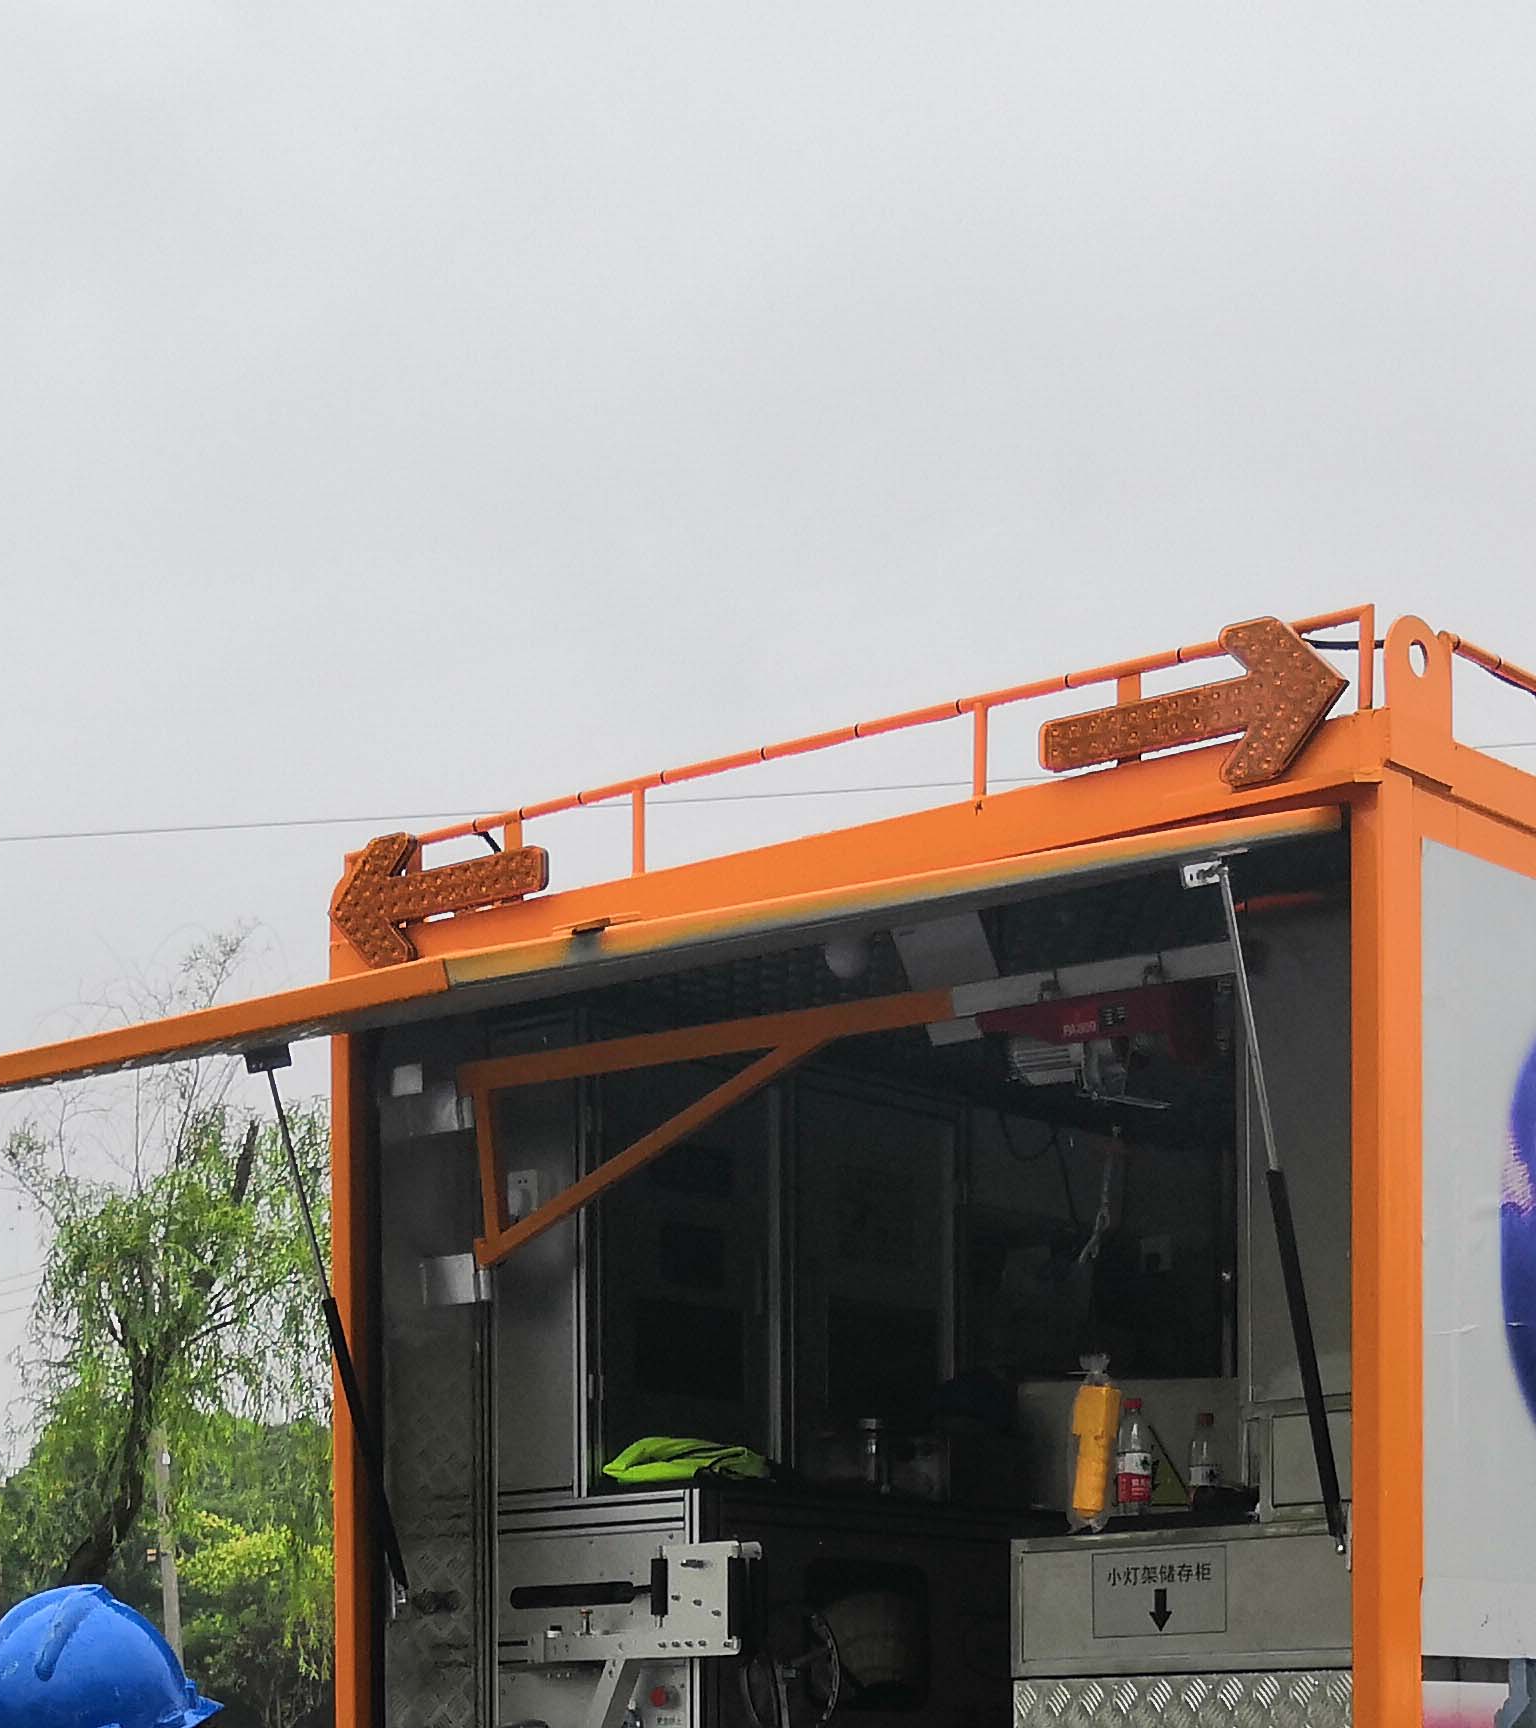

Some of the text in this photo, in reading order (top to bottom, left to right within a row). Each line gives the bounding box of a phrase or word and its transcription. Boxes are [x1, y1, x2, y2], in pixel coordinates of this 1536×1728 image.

[1107, 1562, 1212, 1587] 小灯架储存柜
